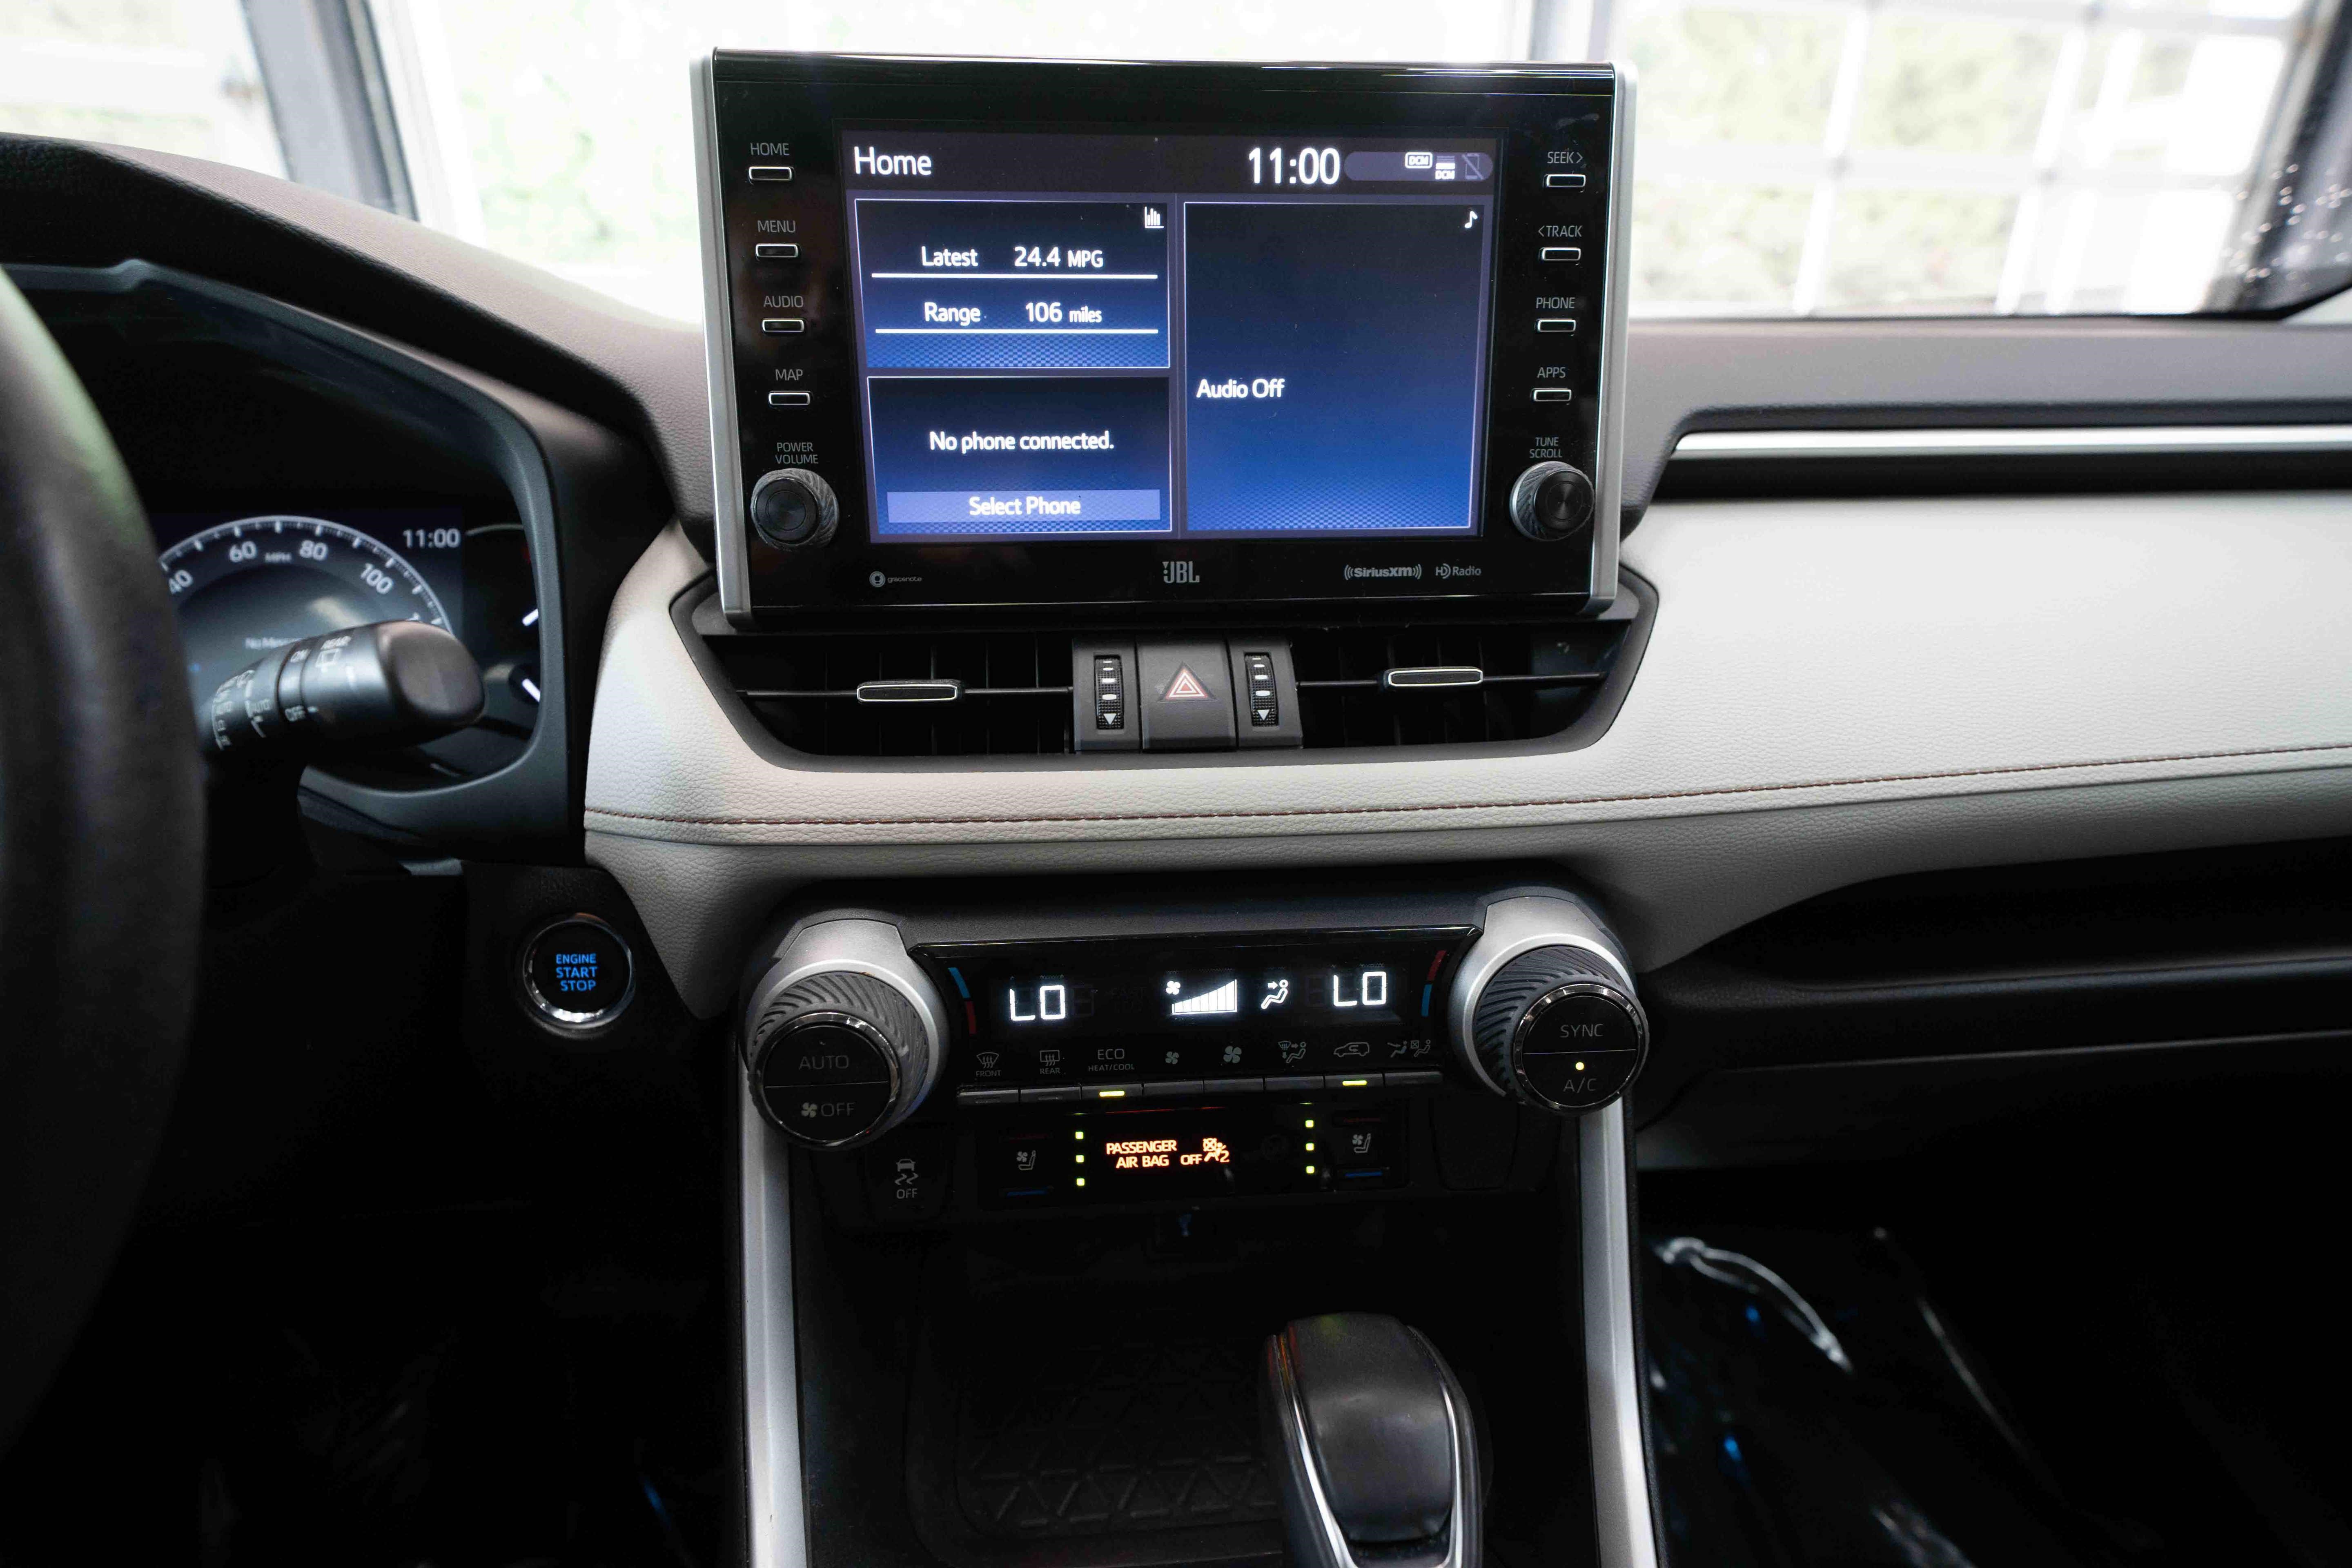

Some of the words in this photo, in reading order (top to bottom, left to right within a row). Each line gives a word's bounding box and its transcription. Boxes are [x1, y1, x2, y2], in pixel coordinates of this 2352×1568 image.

[751, 143, 789, 156] HOME
[854, 147, 932, 176] Home
[1248, 148, 1340, 185] 11:00
[757, 220, 795, 233] MENU
[922, 247, 978, 267] Latest
[1014, 247, 1060, 266] 24.4
[1068, 251, 1104, 267] MPG
[764, 296, 804, 308] AUDIO
[1536, 297, 1575, 309] PHONE
[924, 303, 980, 327] Range
[1026, 303, 1062, 321] 106
[1069, 305, 1102, 323] miles
[775, 369, 803, 381] MAP
[1537, 367, 1566, 379] APPS
[1197, 379, 1249, 398] Audio
[1252, 378, 1285, 397] Off
[777, 442, 813, 452] POWER
[930, 432, 957, 450] No
[961, 432, 1015, 454] phone
[1019, 432, 1114, 450] connected.
[1535, 437, 1559, 447] TUNE
[775, 454, 818, 465] VOLUME
[1530, 448, 1563, 459] SCROLL
[969, 497, 1022, 515] Select
[1026, 497, 1080, 515] Phone
[403, 528, 461, 549] 11:00
[228, 541, 257, 563] 60
[299, 540, 329, 561] 80
[1162, 561, 1200, 583] JBL
[1452, 566, 1481, 576] Radio
[168, 569, 194, 595] 40
[360, 563, 394, 595] 100
[556, 953, 596, 964] ENGINE
[556, 967, 597, 978] START
[560, 980, 596, 991] STOP
[1333, 971, 1387, 1007] LO
[1009, 985, 1066, 1021] LO
[1560, 1024, 1604, 1038] SYNC
[1098, 1049, 1125, 1060] ECO
[799, 1055, 849, 1070] AUTO
[1088, 1063, 1135, 1071] HEAT/COOL
[1563, 1076, 1597, 1093] A/C
[820, 1101, 857, 1117] OFF
[1106, 1140, 1177, 1154] PASSENGER
[1116, 1157, 1138, 1168] AIR
[1142, 1154, 1169, 1167] BAG
[1180, 1154, 1202, 1165] OFF
[896, 1188, 918, 1199] OFF
